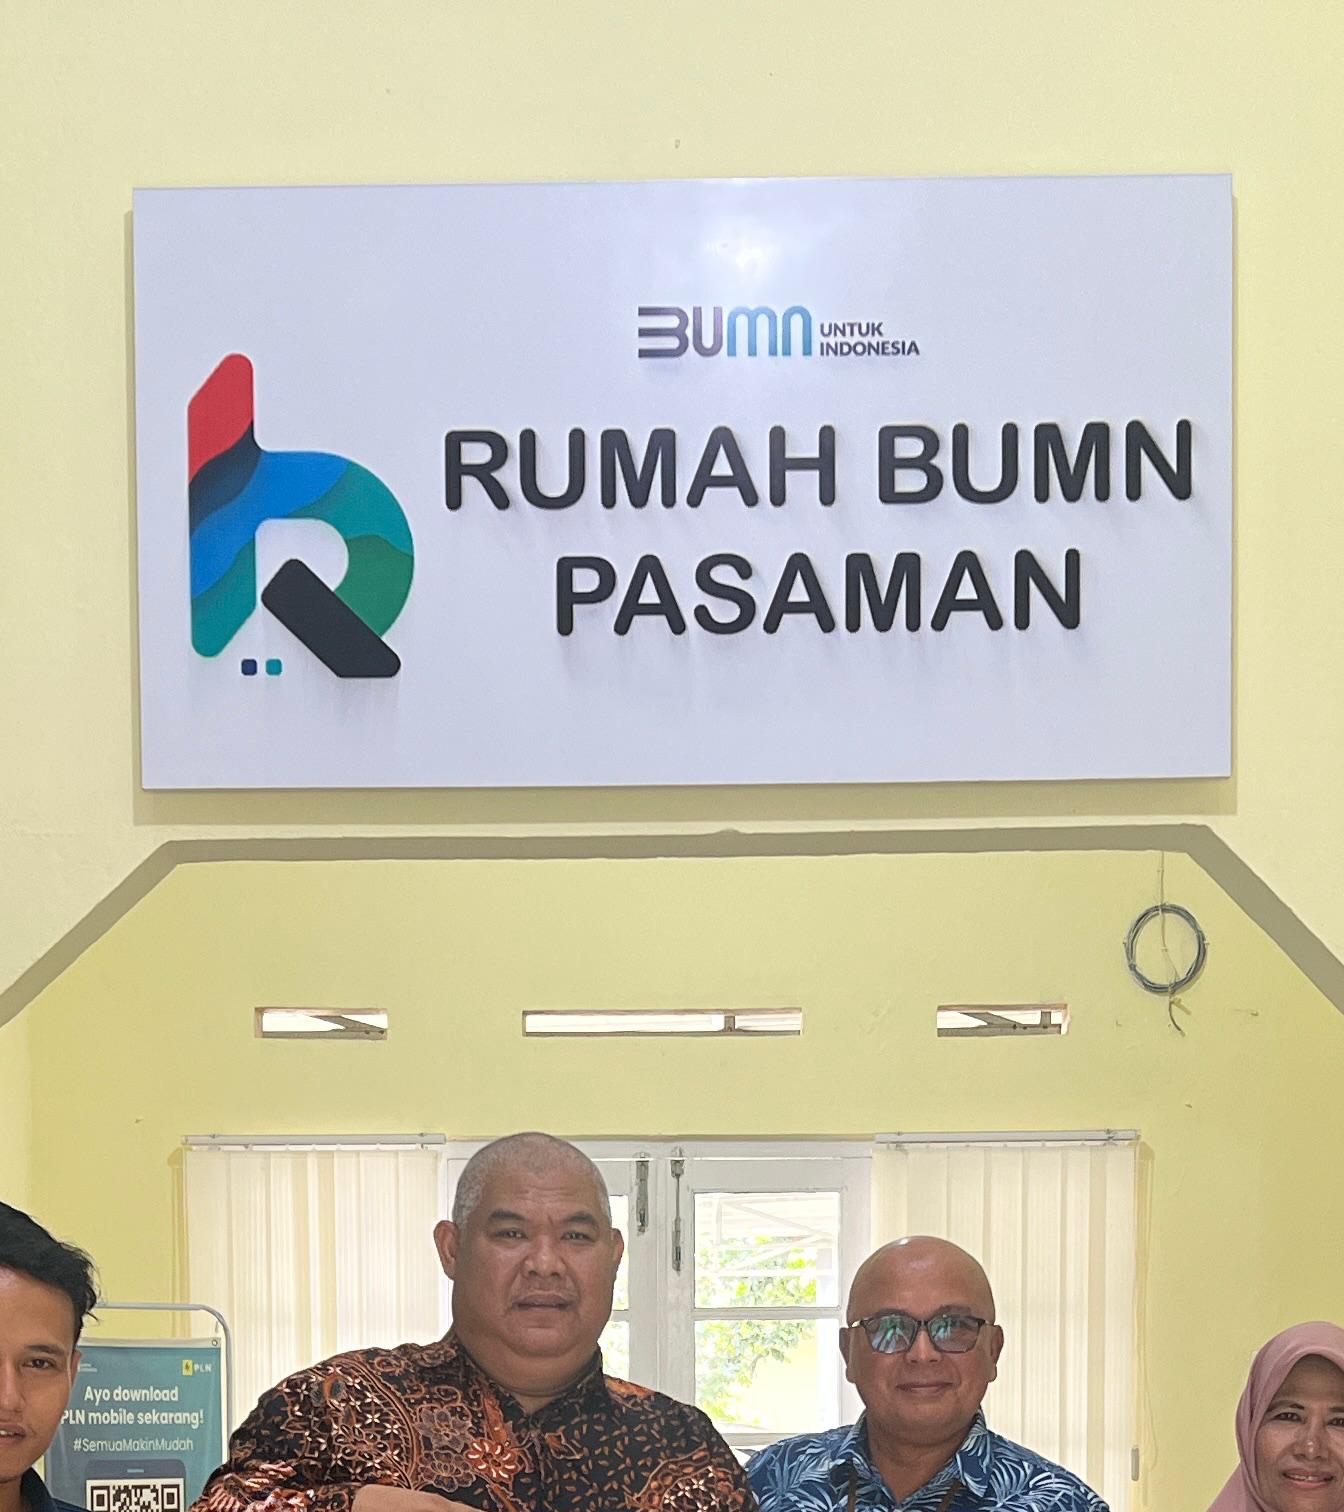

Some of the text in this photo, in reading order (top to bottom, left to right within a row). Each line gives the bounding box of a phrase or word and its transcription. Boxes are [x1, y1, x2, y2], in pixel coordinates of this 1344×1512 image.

[637, 305, 813, 358] BUMN
[820, 321, 884, 338] UNTUK
[820, 340, 920, 357] INDONESIA
[444, 419, 1194, 512] RUMAH BUMN
[556, 548, 1082, 637] PASAMAN
[84, 1385, 179, 1406] Ayo download
[60, 1408, 204, 1430] PLN mobile sekarang!
[73, 1437, 194, 1452] #SemuaMakinMudah
